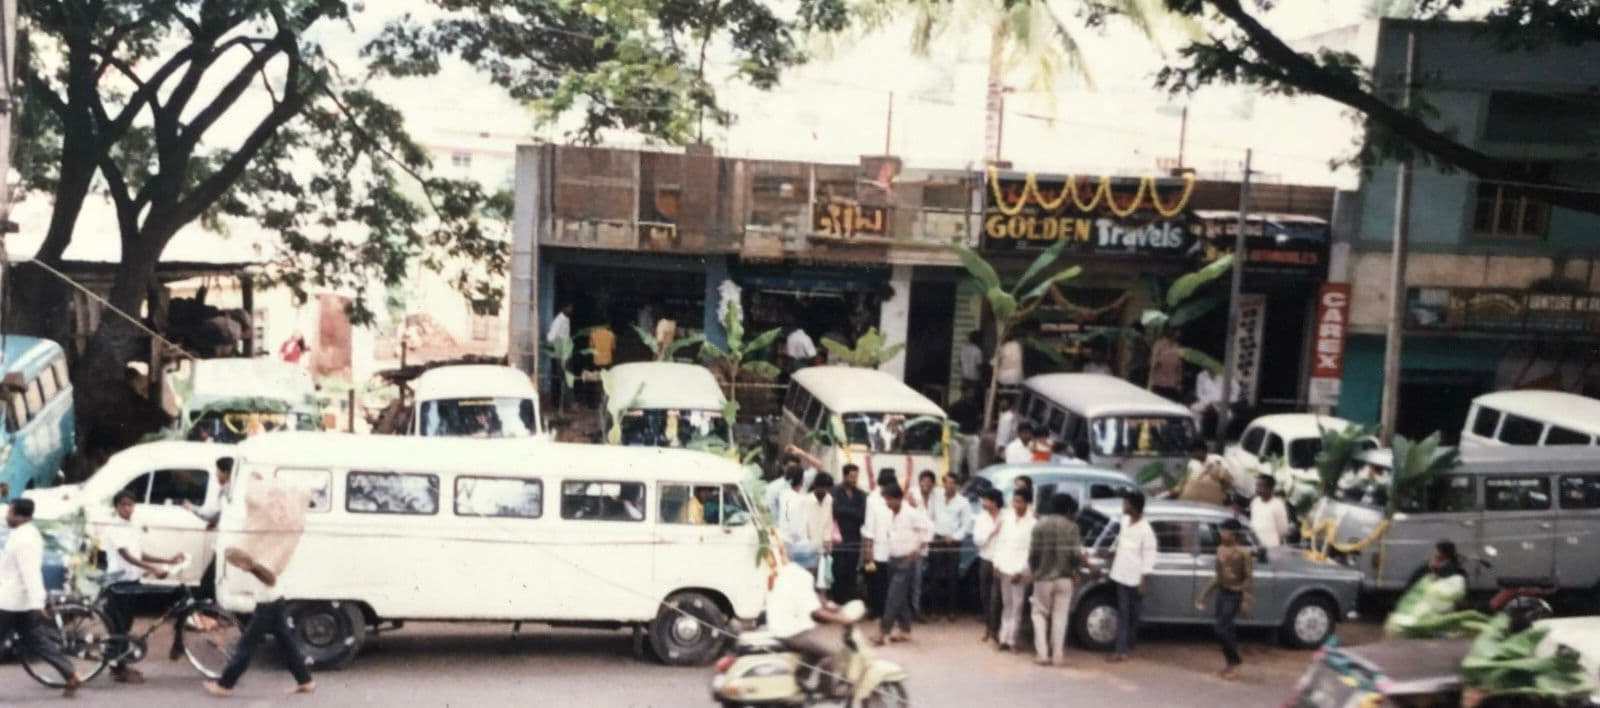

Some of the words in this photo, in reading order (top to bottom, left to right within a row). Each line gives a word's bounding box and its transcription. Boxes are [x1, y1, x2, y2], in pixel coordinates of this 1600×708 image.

[985, 214, 1091, 241] GOLDEN
[1096, 218, 1183, 248] Travels
[1317, 292, 1347, 369] CAREX
